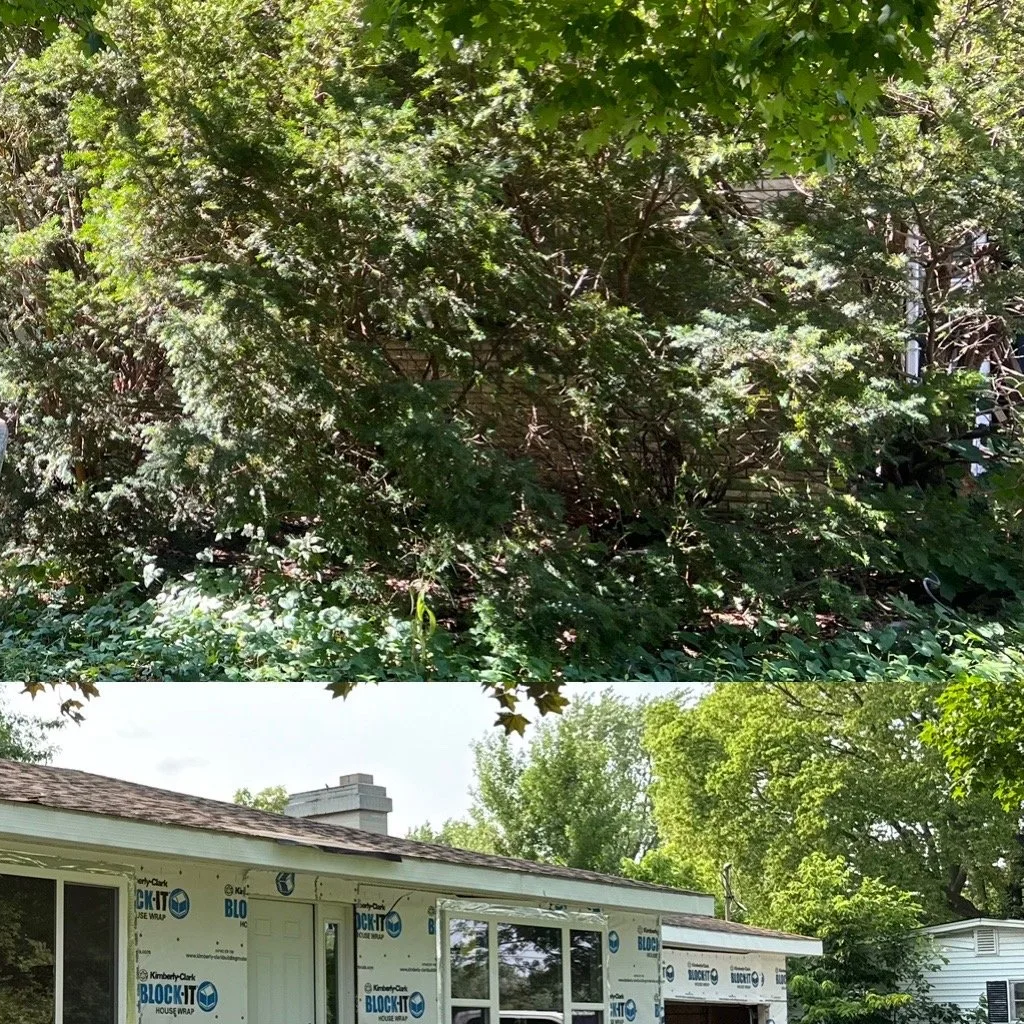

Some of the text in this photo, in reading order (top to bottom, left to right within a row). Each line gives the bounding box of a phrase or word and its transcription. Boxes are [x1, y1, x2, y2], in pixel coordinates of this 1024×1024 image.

[149, 912, 166, 921] WRAP
[149, 971, 196, 982] Kimberly-Clark
[373, 984, 408, 993] Kimberly-Clark
[139, 983, 197, 1006] BLOCK-IT
[365, 994, 409, 1014] BLOCK-IT
[156, 1006, 195, 1016] HOUSE WRAP
